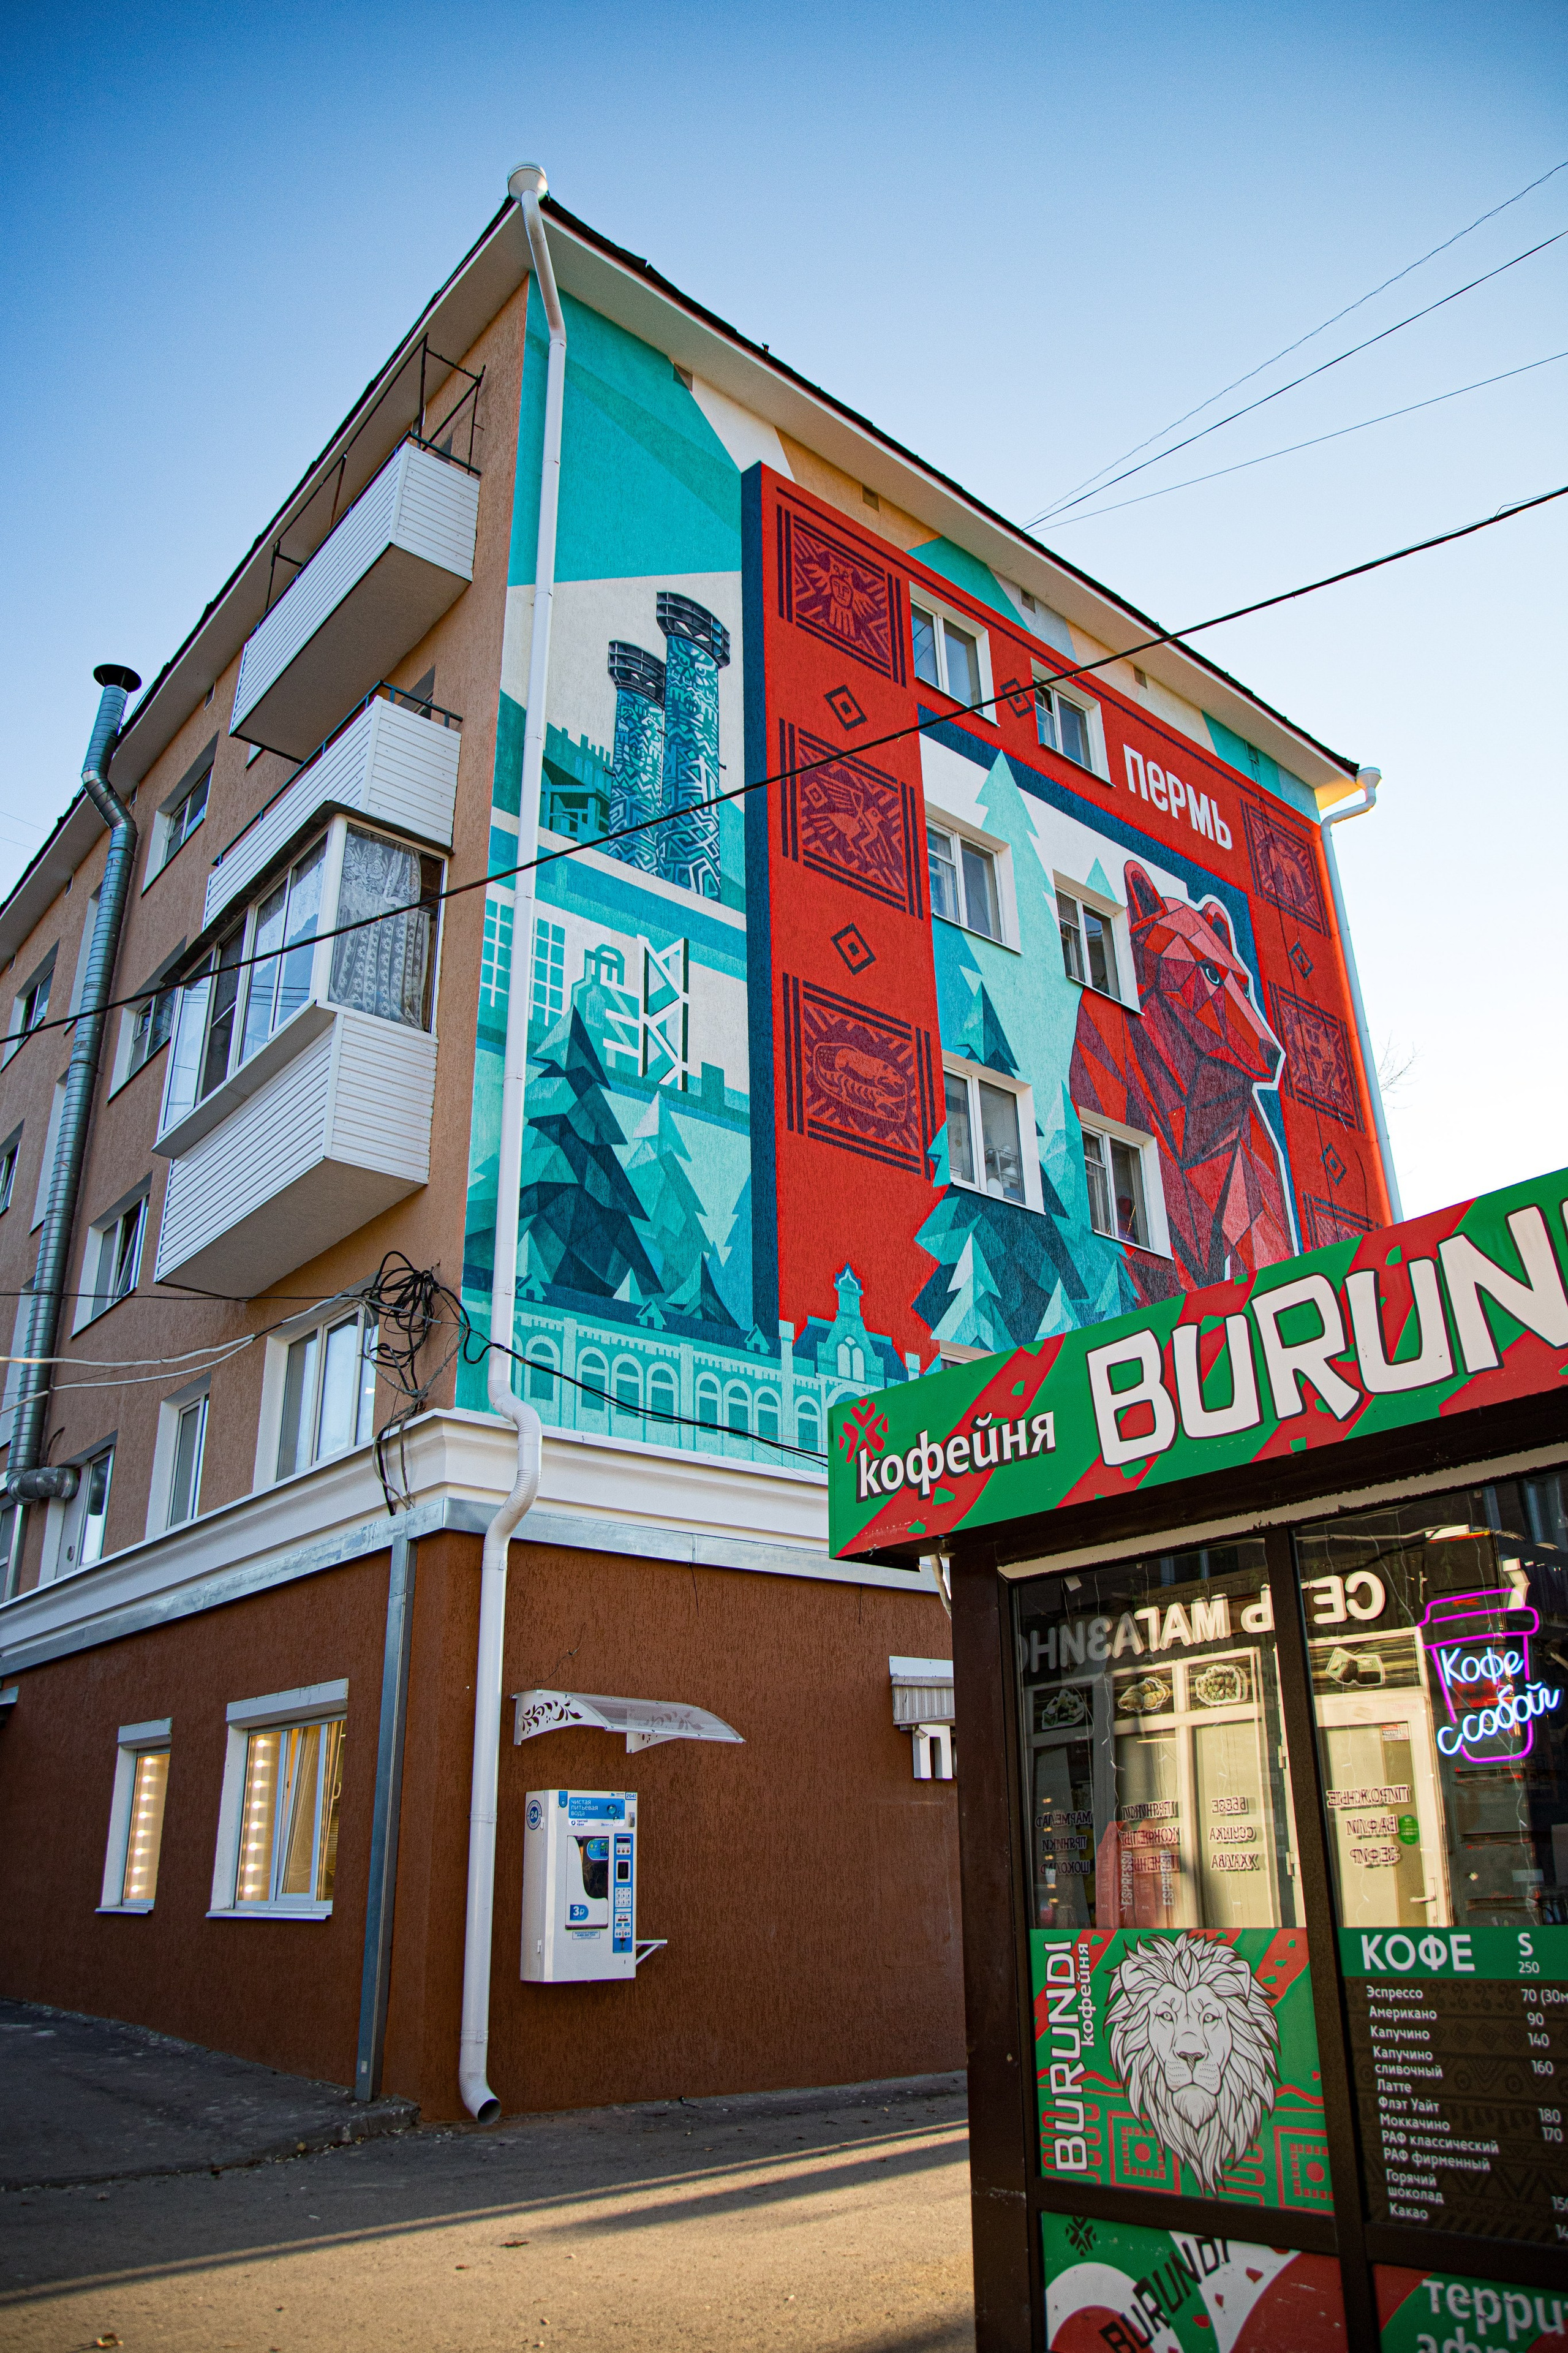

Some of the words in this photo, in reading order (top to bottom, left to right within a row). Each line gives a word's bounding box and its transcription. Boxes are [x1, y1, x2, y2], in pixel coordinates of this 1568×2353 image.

[1087, 1198, 1568, 1468] BURUN
[858, 1411, 1056, 1500] кофейня
[1440, 1647, 1525, 1686] Кофе
[1437, 1726, 1463, 1756] с
[1462, 1682, 1560, 1743] собой
[530, 1810, 537, 1819] 24
[1121, 1851, 1133, 1905] ESPRESSO
[1361, 1934, 1475, 1971] КОФЕ
[1518, 1933, 1533, 1956] S
[1518, 1961, 1540, 1974] 250
[1077, 1943, 1095, 2047] кофейня
[1366, 1985, 1423, 2001] Эспрессо
[1521, 1989, 1537, 2001] 70
[1370, 2006, 1437, 2022] Американо
[1527, 2012, 1544, 2025] 90
[1370, 2025, 1430, 2042] Капучино
[1528, 2033, 1550, 2047] 140
[1044, 1941, 1088, 2172] BURUNDI
[1373, 2045, 1433, 2062] Капучино
[1375, 2063, 1443, 2077] сливочный
[1531, 2060, 1554, 2075] 160
[1377, 2078, 1412, 2093] Латте
[1378, 2096, 1408, 2109] Флэт
[1411, 2098, 1440, 2113] Уайт
[1380, 2113, 1450, 2131] Моккачино
[1538, 2108, 1561, 2123] 180
[1381, 2129, 1407, 2143] РАФ
[1409, 2134, 1499, 2155] классический
[1542, 2126, 1563, 2142] 170
[1383, 2147, 1409, 2161] РАФ
[1411, 2150, 1491, 2171] фирменный
[1385, 2168, 1436, 2186] Горячий
[1387, 2186, 1444, 2204] шоколад
[1389, 2202, 1428, 2220] Какао
[1422, 2279, 1568, 2341] терри
